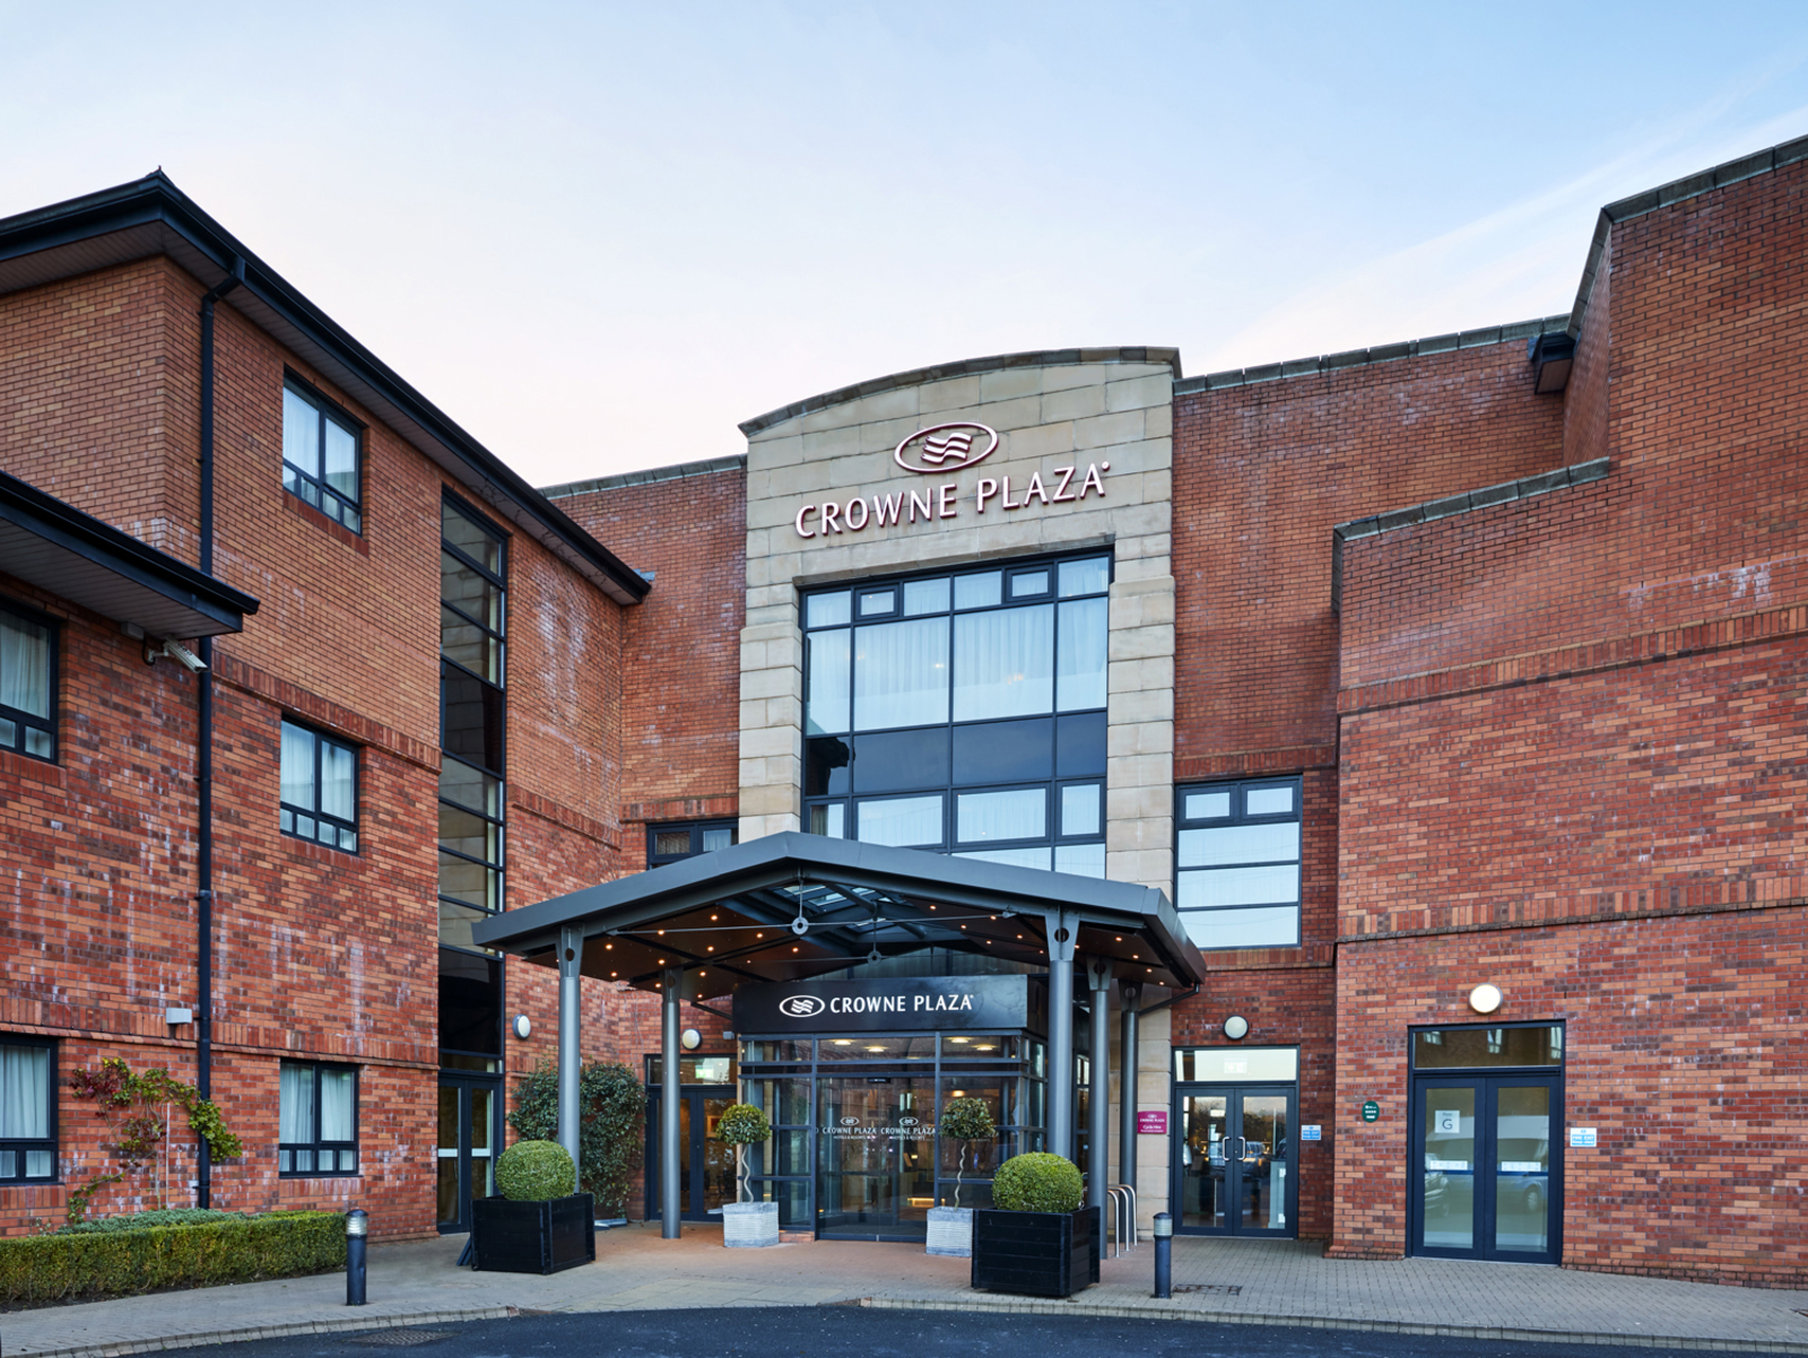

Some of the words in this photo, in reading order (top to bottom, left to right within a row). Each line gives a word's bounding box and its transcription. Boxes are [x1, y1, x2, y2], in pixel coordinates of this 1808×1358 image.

[795, 483, 958, 538] CROWNE
[976, 462, 1107, 513] PLAZA
[830, 996, 906, 1013] CROWNE
[914, 994, 973, 1012] PLAZA
[1442, 1118, 1453, 1130] G
[854, 1127, 877, 1135] PLAZA
[880, 1127, 911, 1135] CROWNE
[913, 1127, 937, 1135] PLAZA
